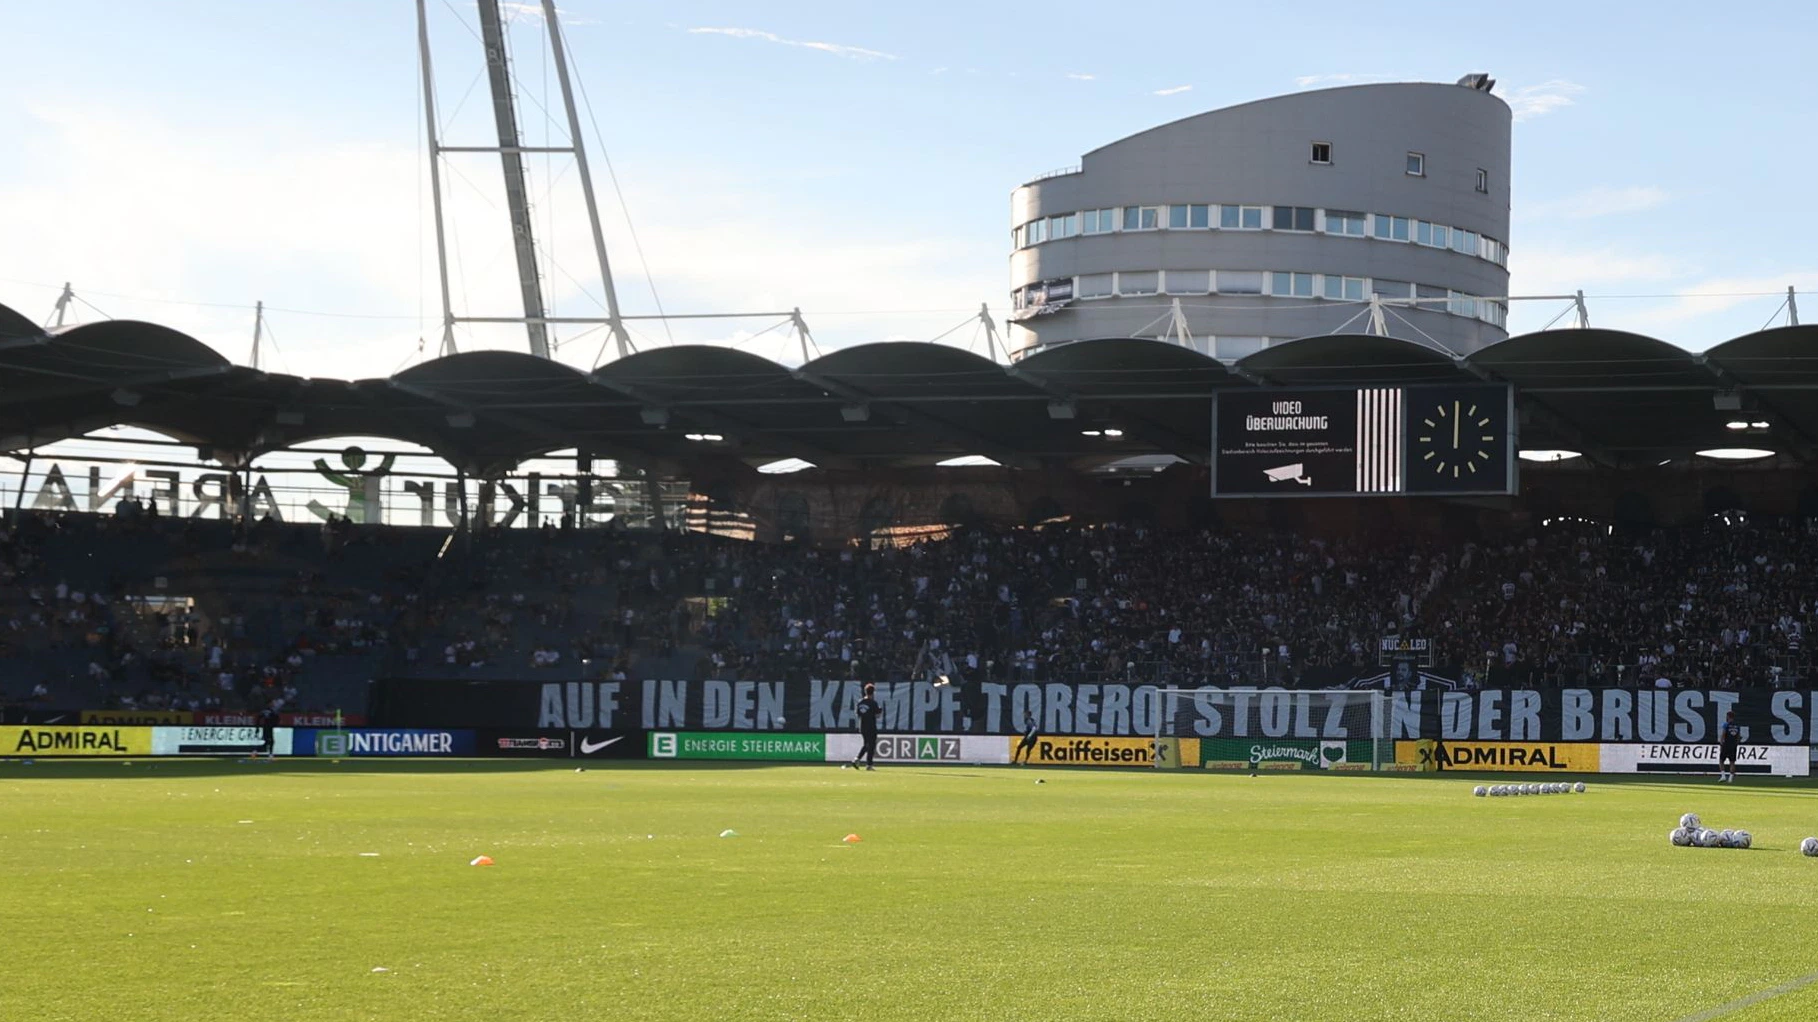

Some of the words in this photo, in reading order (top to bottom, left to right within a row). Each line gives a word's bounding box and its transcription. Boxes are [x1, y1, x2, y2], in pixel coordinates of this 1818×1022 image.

[1272, 401, 1302, 415] VIDEO
[1246, 415, 1328, 431] ÜBERWACHUNG
[205, 715, 254, 725] KLEINE
[538, 682, 620, 729] AUF
[642, 680, 686, 729] IN
[703, 680, 785, 729] DEN
[982, 682, 1178, 735] TORERO!
[1193, 685, 1347, 737] STOLZ
[1441, 689, 1541, 740] DER
[16, 729, 127, 752] ADMIRAL
[187, 728, 236, 741] ENERGIE
[240, 728, 264, 741] GRA
[346, 732, 453, 753] UNTIGAMER
[684, 738, 737, 753] ENERGIE
[742, 739, 820, 753] STEIERMARK
[876, 738, 959, 759] GRAZ
[1040, 740, 1148, 762] Raiffeisen
[1250, 745, 1320, 765] Steiermark
[1650, 747, 1717, 760] ENERGIE
[1737, 748, 1768, 761] RAZ
[1439, 746, 1567, 769] ADMIRAL
